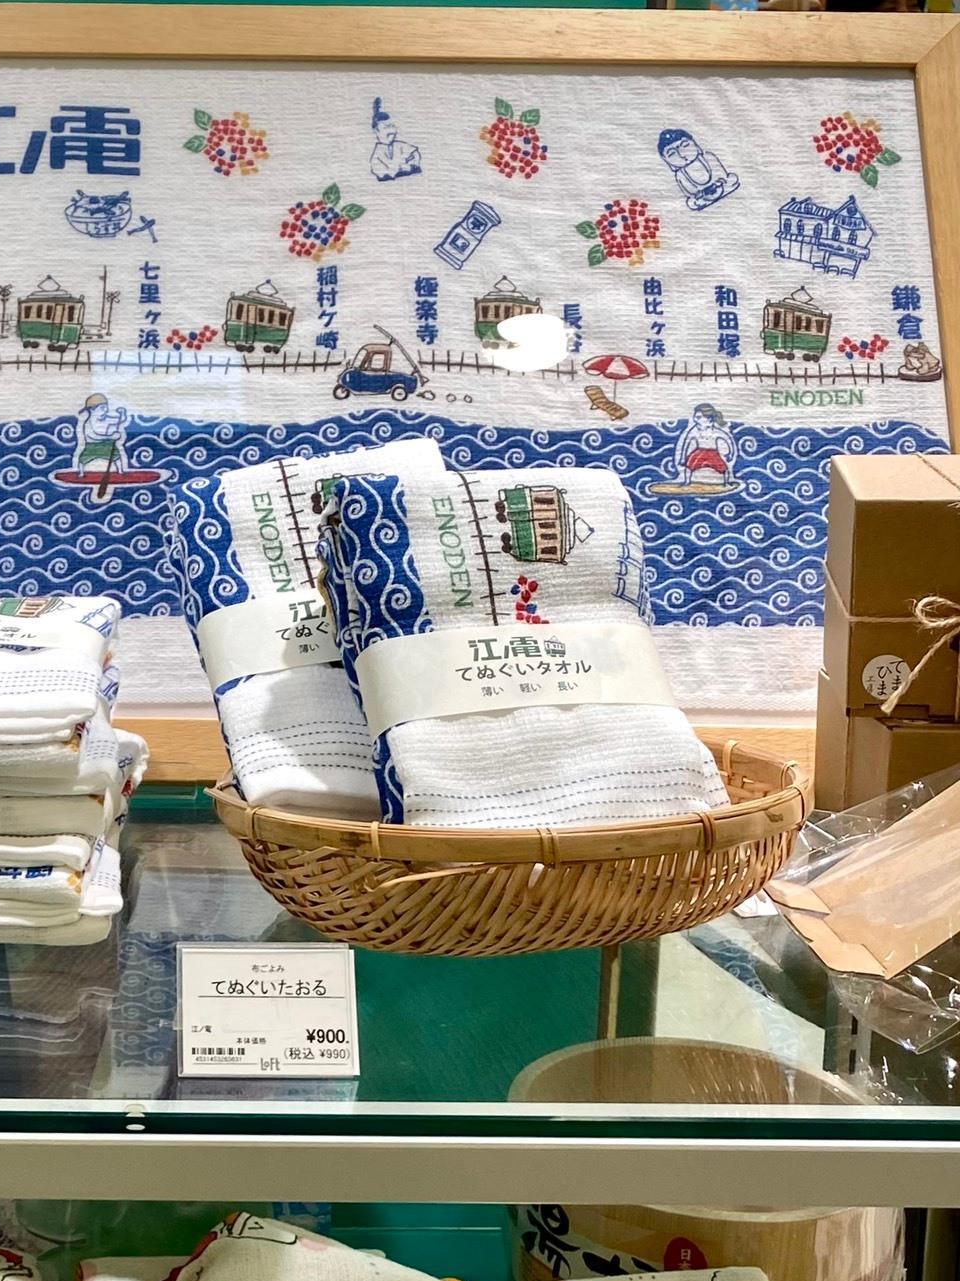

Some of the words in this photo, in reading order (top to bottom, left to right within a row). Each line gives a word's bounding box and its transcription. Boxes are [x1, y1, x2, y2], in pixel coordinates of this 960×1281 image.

[414, 276, 439, 345] 極楽寺
[714, 285, 741, 358] 和田塚
[891, 285, 924, 340] 鎌倉
[770, 389, 864, 408] ENODEN
[252, 492, 295, 593] ENODEN
[432, 496, 474, 609] ENODEN
[468, 636, 542, 661] 江ノ電
[455, 660, 592, 682] てぬぐいタオル
[481, 686, 504, 697] 薄い
[519, 682, 542, 693] 軽い
[558, 681, 579, 691] 長い
[211, 979, 327, 996] てぬぐいたおる
